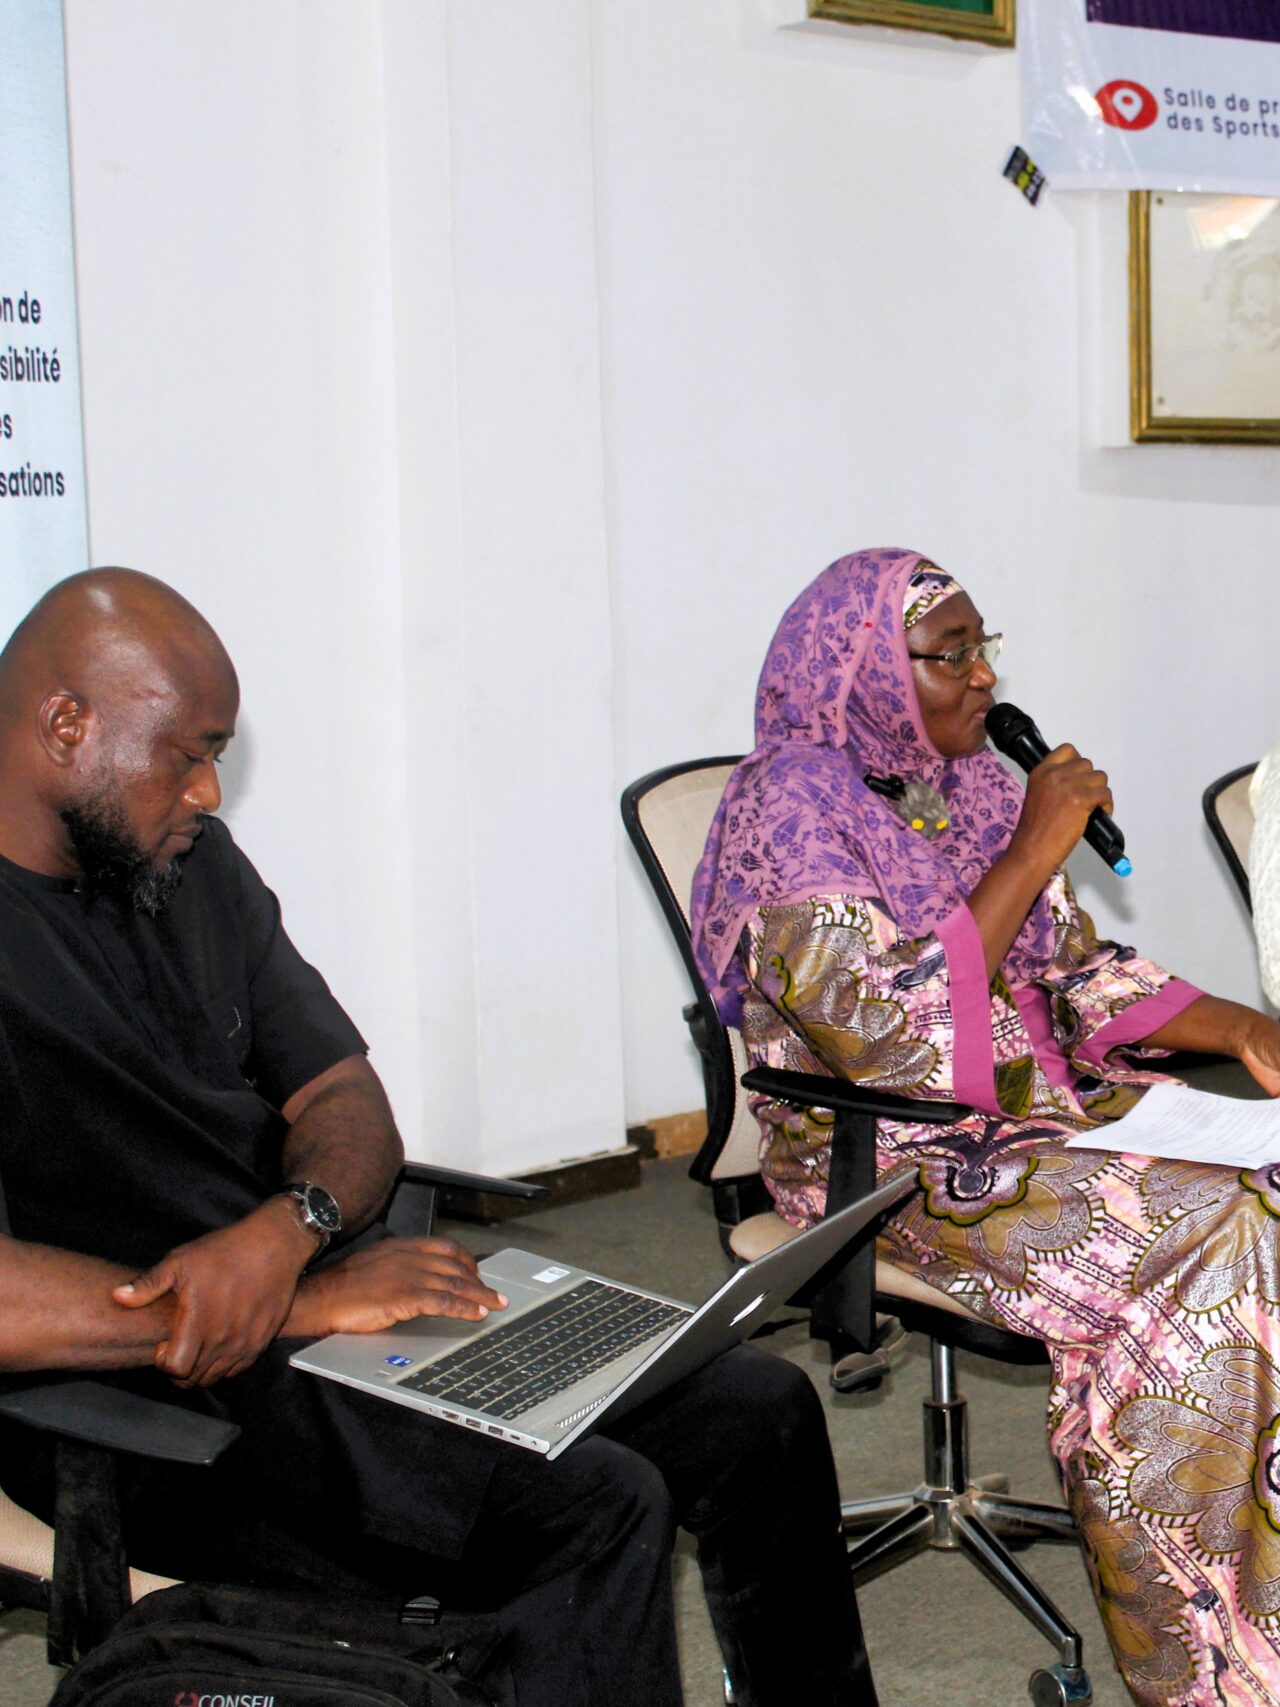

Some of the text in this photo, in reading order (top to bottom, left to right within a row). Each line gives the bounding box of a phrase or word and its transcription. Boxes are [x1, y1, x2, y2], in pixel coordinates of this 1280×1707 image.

[1164, 88, 1215, 109] Salle
[1226, 94, 1249, 112] de
[1167, 114, 1203, 133] des
[1213, 118, 1280, 140] Sports
[19, 291, 41, 324] de
